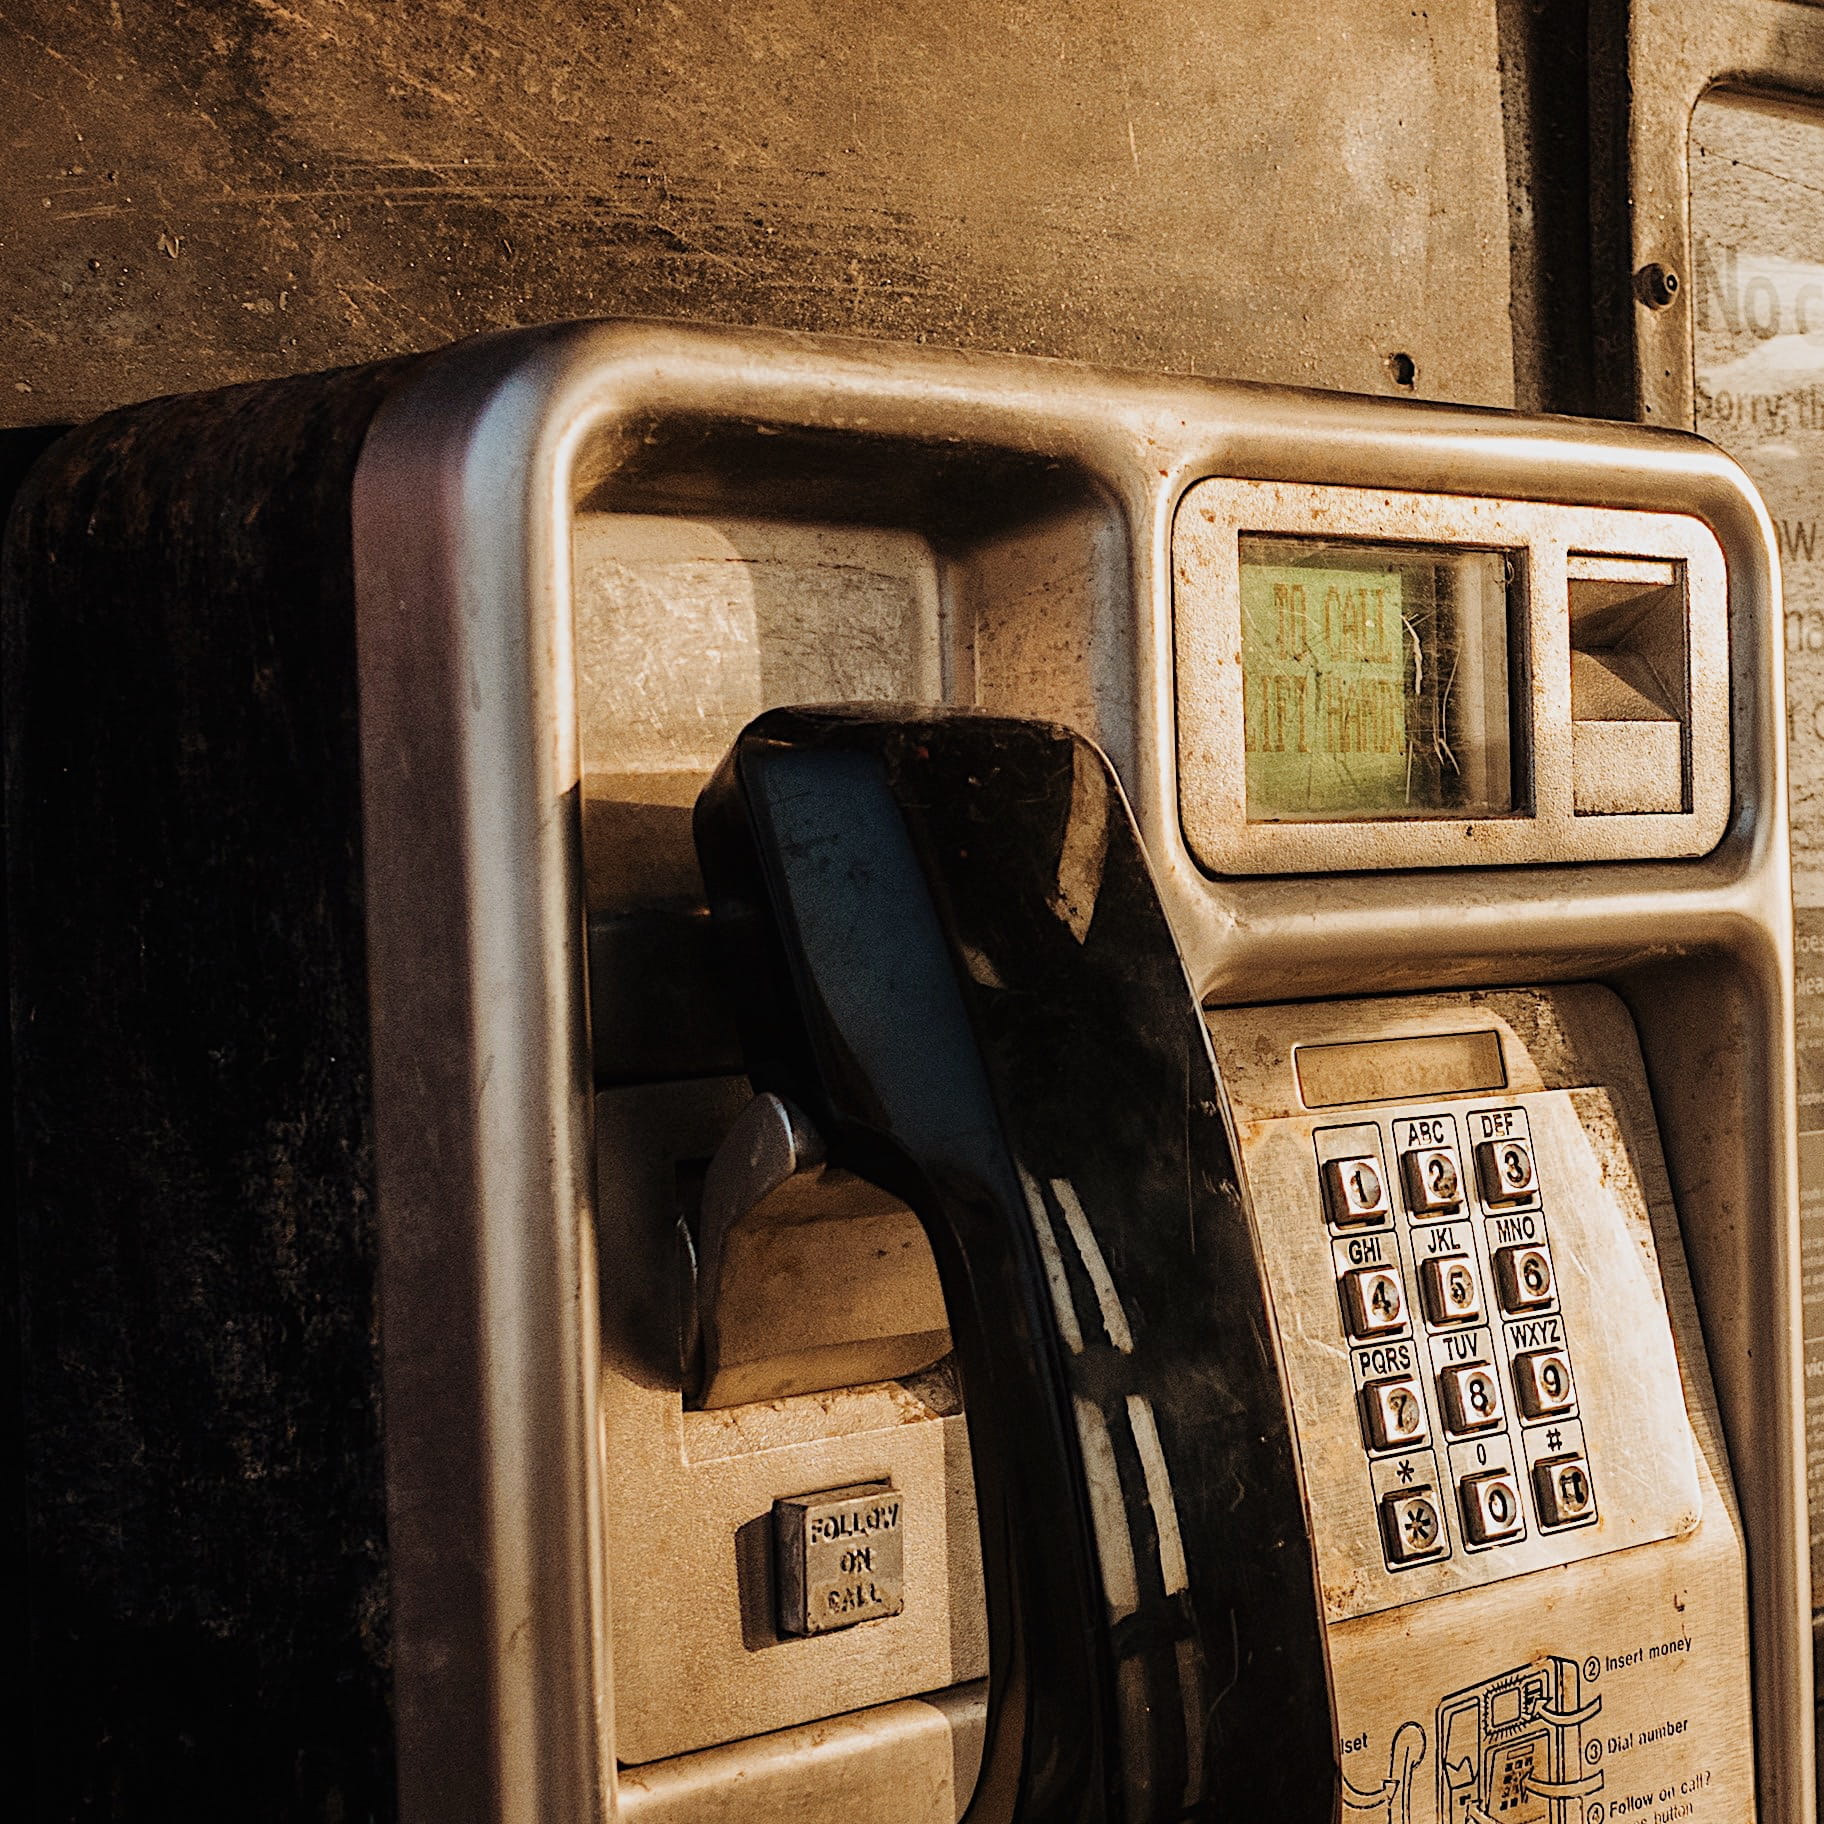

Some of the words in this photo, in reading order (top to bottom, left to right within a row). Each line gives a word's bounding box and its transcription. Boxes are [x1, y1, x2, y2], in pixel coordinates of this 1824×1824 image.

[1694, 242, 1780, 341] No
[1273, 583, 1307, 661] TO
[1324, 586, 1393, 664] CALL
[1408, 1120, 1444, 1147] ABC
[1481, 1113, 1513, 1137] DEF
[1504, 1151, 1524, 1183] 3
[1353, 1170, 1367, 1203] 1
[1428, 1227, 1461, 1253] JKL
[1496, 1216, 1535, 1243] MNO
[1348, 1237, 1382, 1264] GHI
[1450, 1272, 1466, 1303] 5
[1523, 1258, 1542, 1291] 6
[1372, 1281, 1391, 1313] 4
[1443, 1333, 1477, 1361] TUV
[1509, 1319, 1560, 1349] WXYZ
[1359, 1345, 1411, 1377] PQRS
[1469, 1379, 1488, 1411] 8
[1542, 1364, 1561, 1398] 9
[1489, 1490, 1508, 1523] 0
[811, 1503, 899, 1543] FOLLOW
[841, 1547, 872, 1573] ON
[829, 1583, 882, 1613] CALL
[1605, 1648, 1643, 1671] Insert
[1649, 1637, 1692, 1659] money
[1608, 1733, 1632, 1753] Dial
[1639, 1720, 1688, 1745] number
[1609, 1793, 1653, 1818] Follow
[1659, 1787, 1675, 1802] on
[1681, 1771, 1711, 1795] call?
[1654, 1802, 1693, 1824] button
